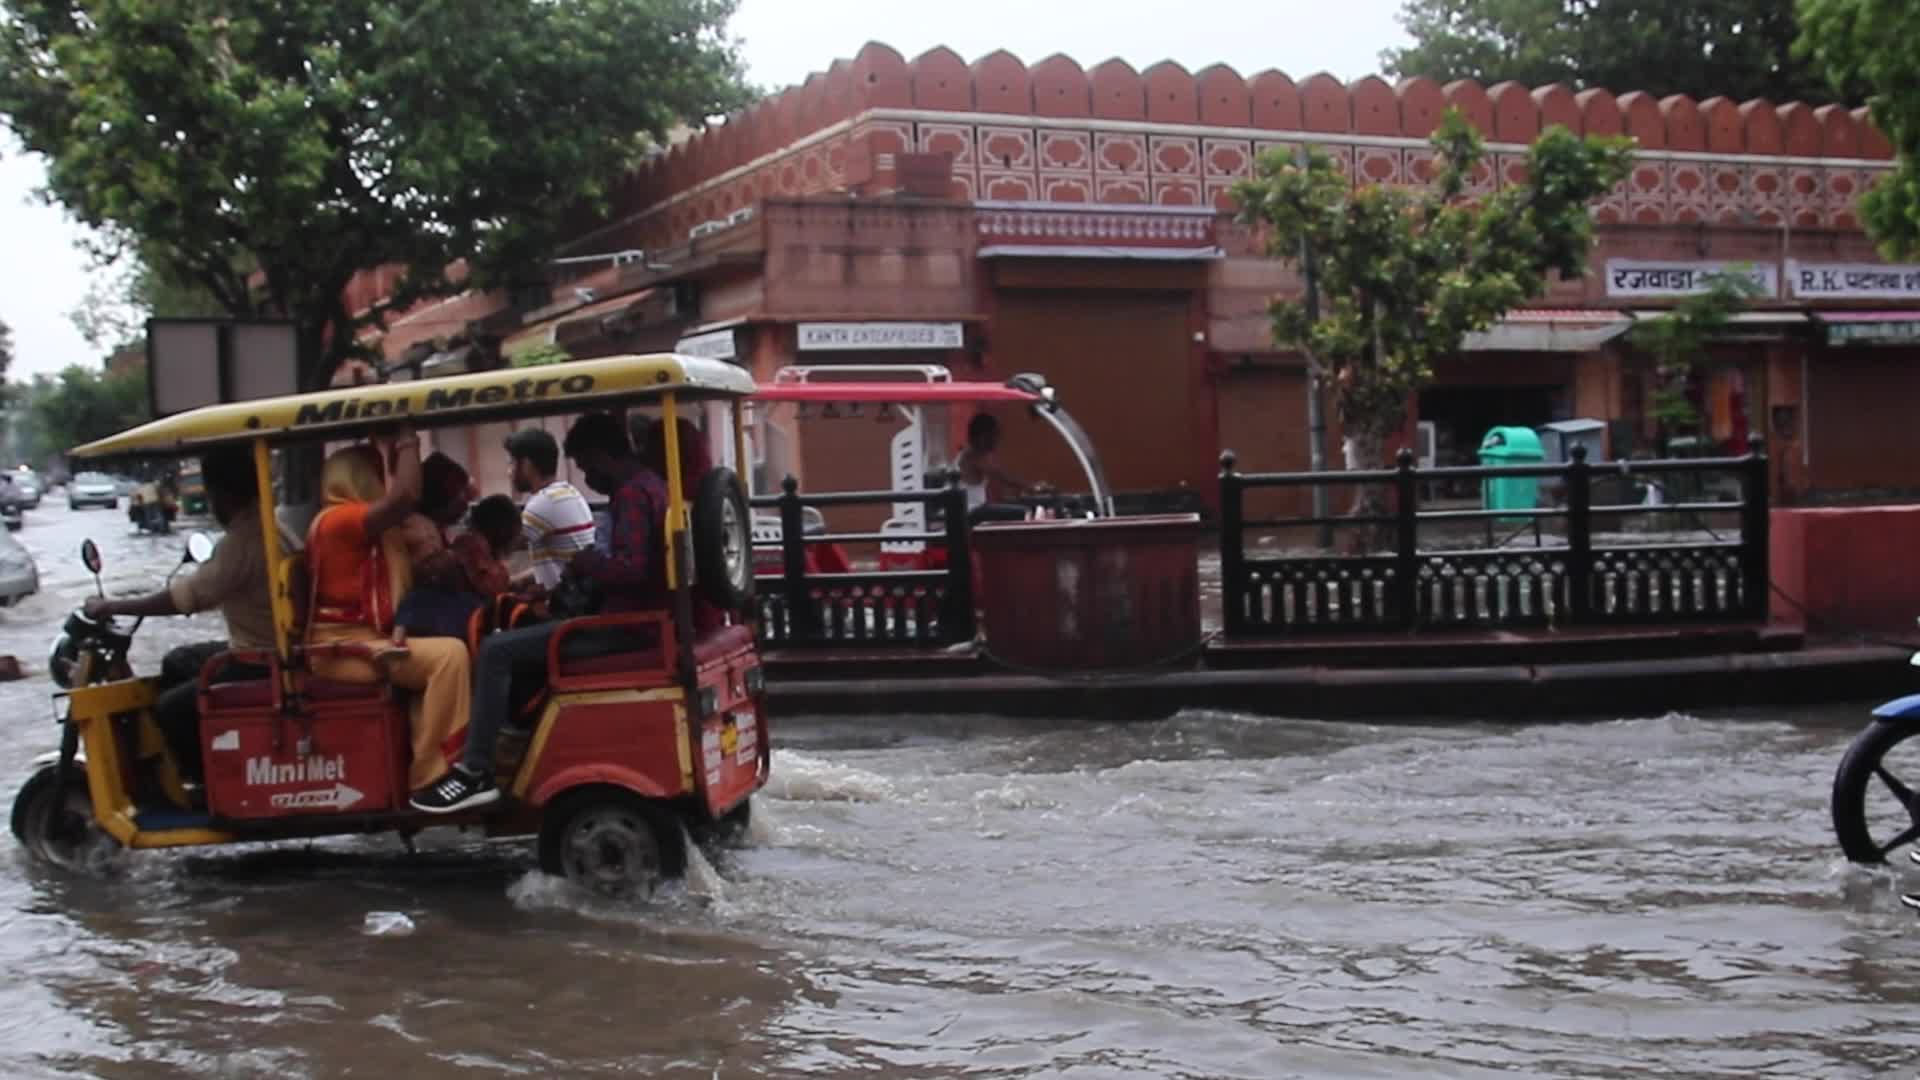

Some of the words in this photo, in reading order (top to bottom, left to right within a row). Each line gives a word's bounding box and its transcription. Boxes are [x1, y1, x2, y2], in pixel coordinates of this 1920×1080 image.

[296, 398, 409, 425] Mini
[425, 374, 596, 411] Metro
[246, 756, 304, 785] Mini
